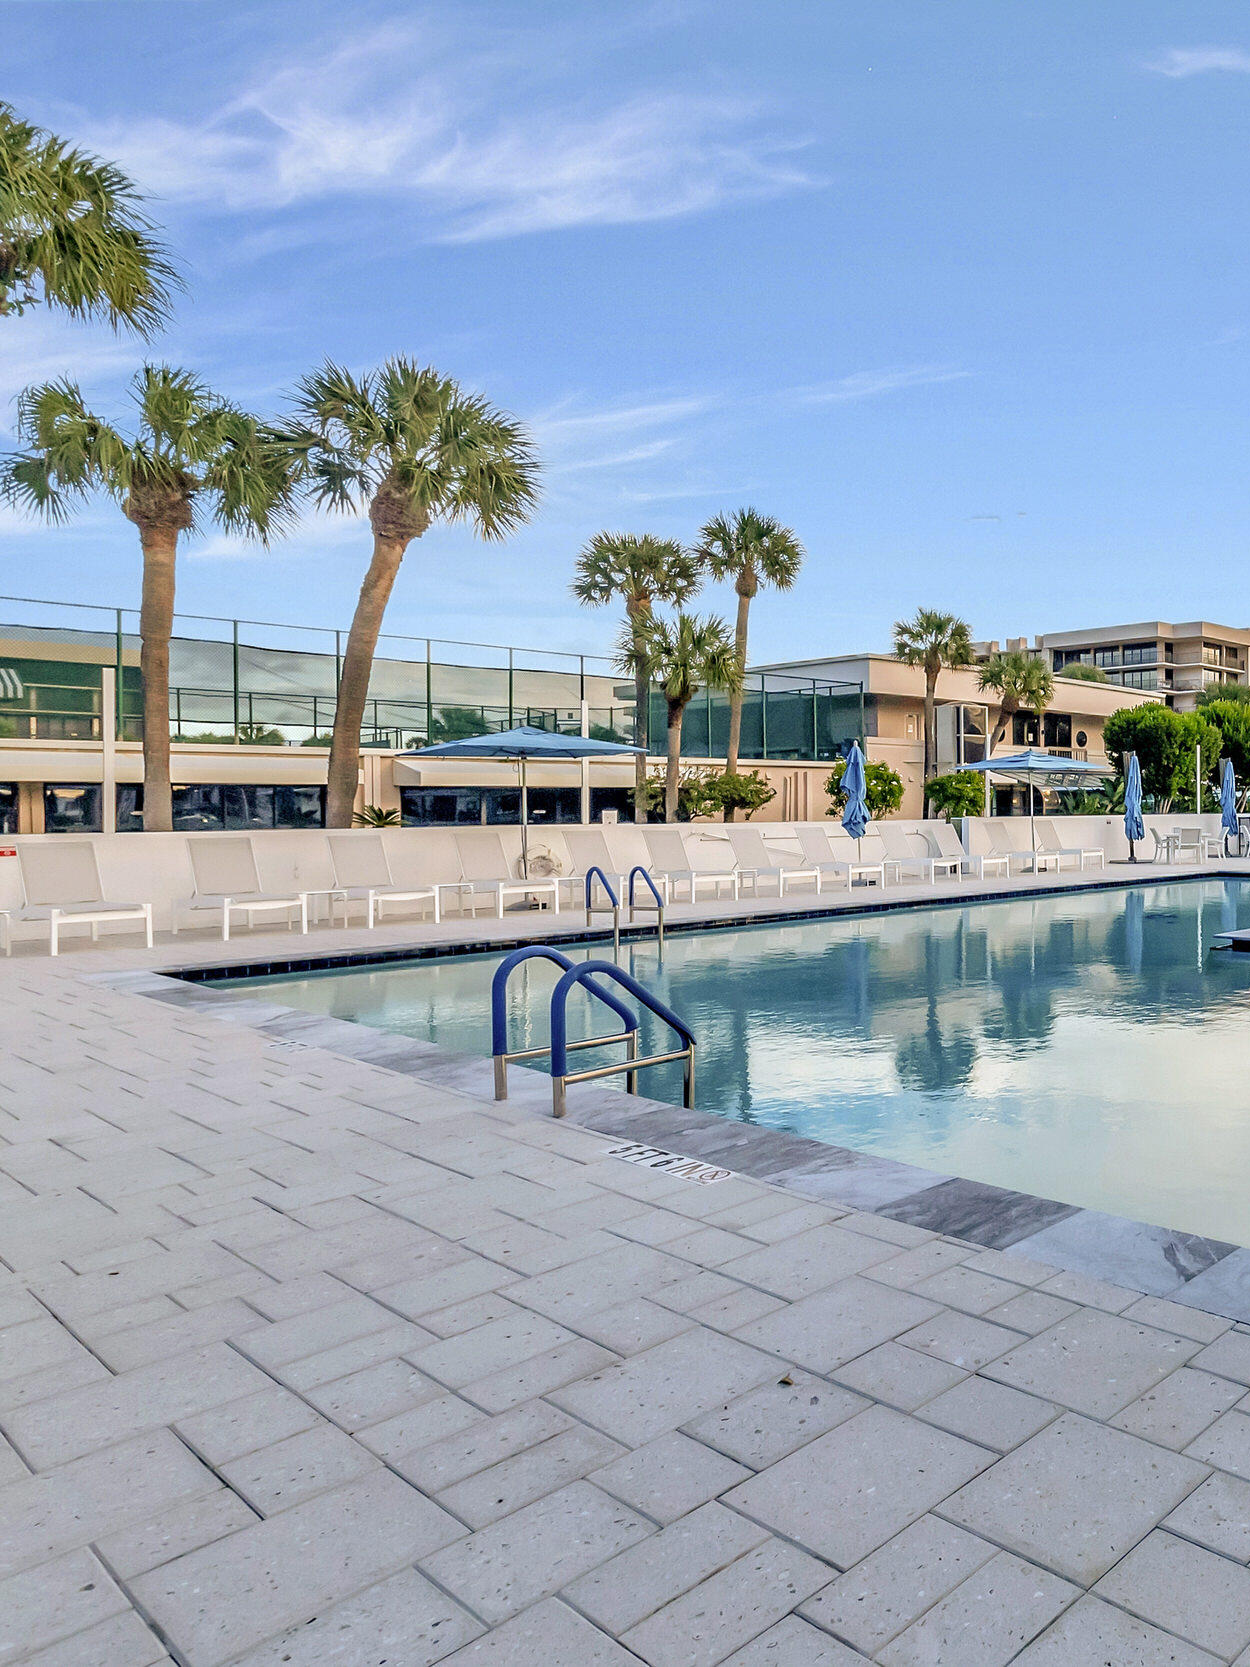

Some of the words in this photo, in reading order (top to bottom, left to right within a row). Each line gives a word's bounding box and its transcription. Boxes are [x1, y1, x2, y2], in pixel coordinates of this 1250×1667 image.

[608, 1144, 644, 1154] 5
[622, 1148, 670, 1162] FT
[650, 1157, 685, 1167] 6
[665, 1161, 713, 1176] IN
